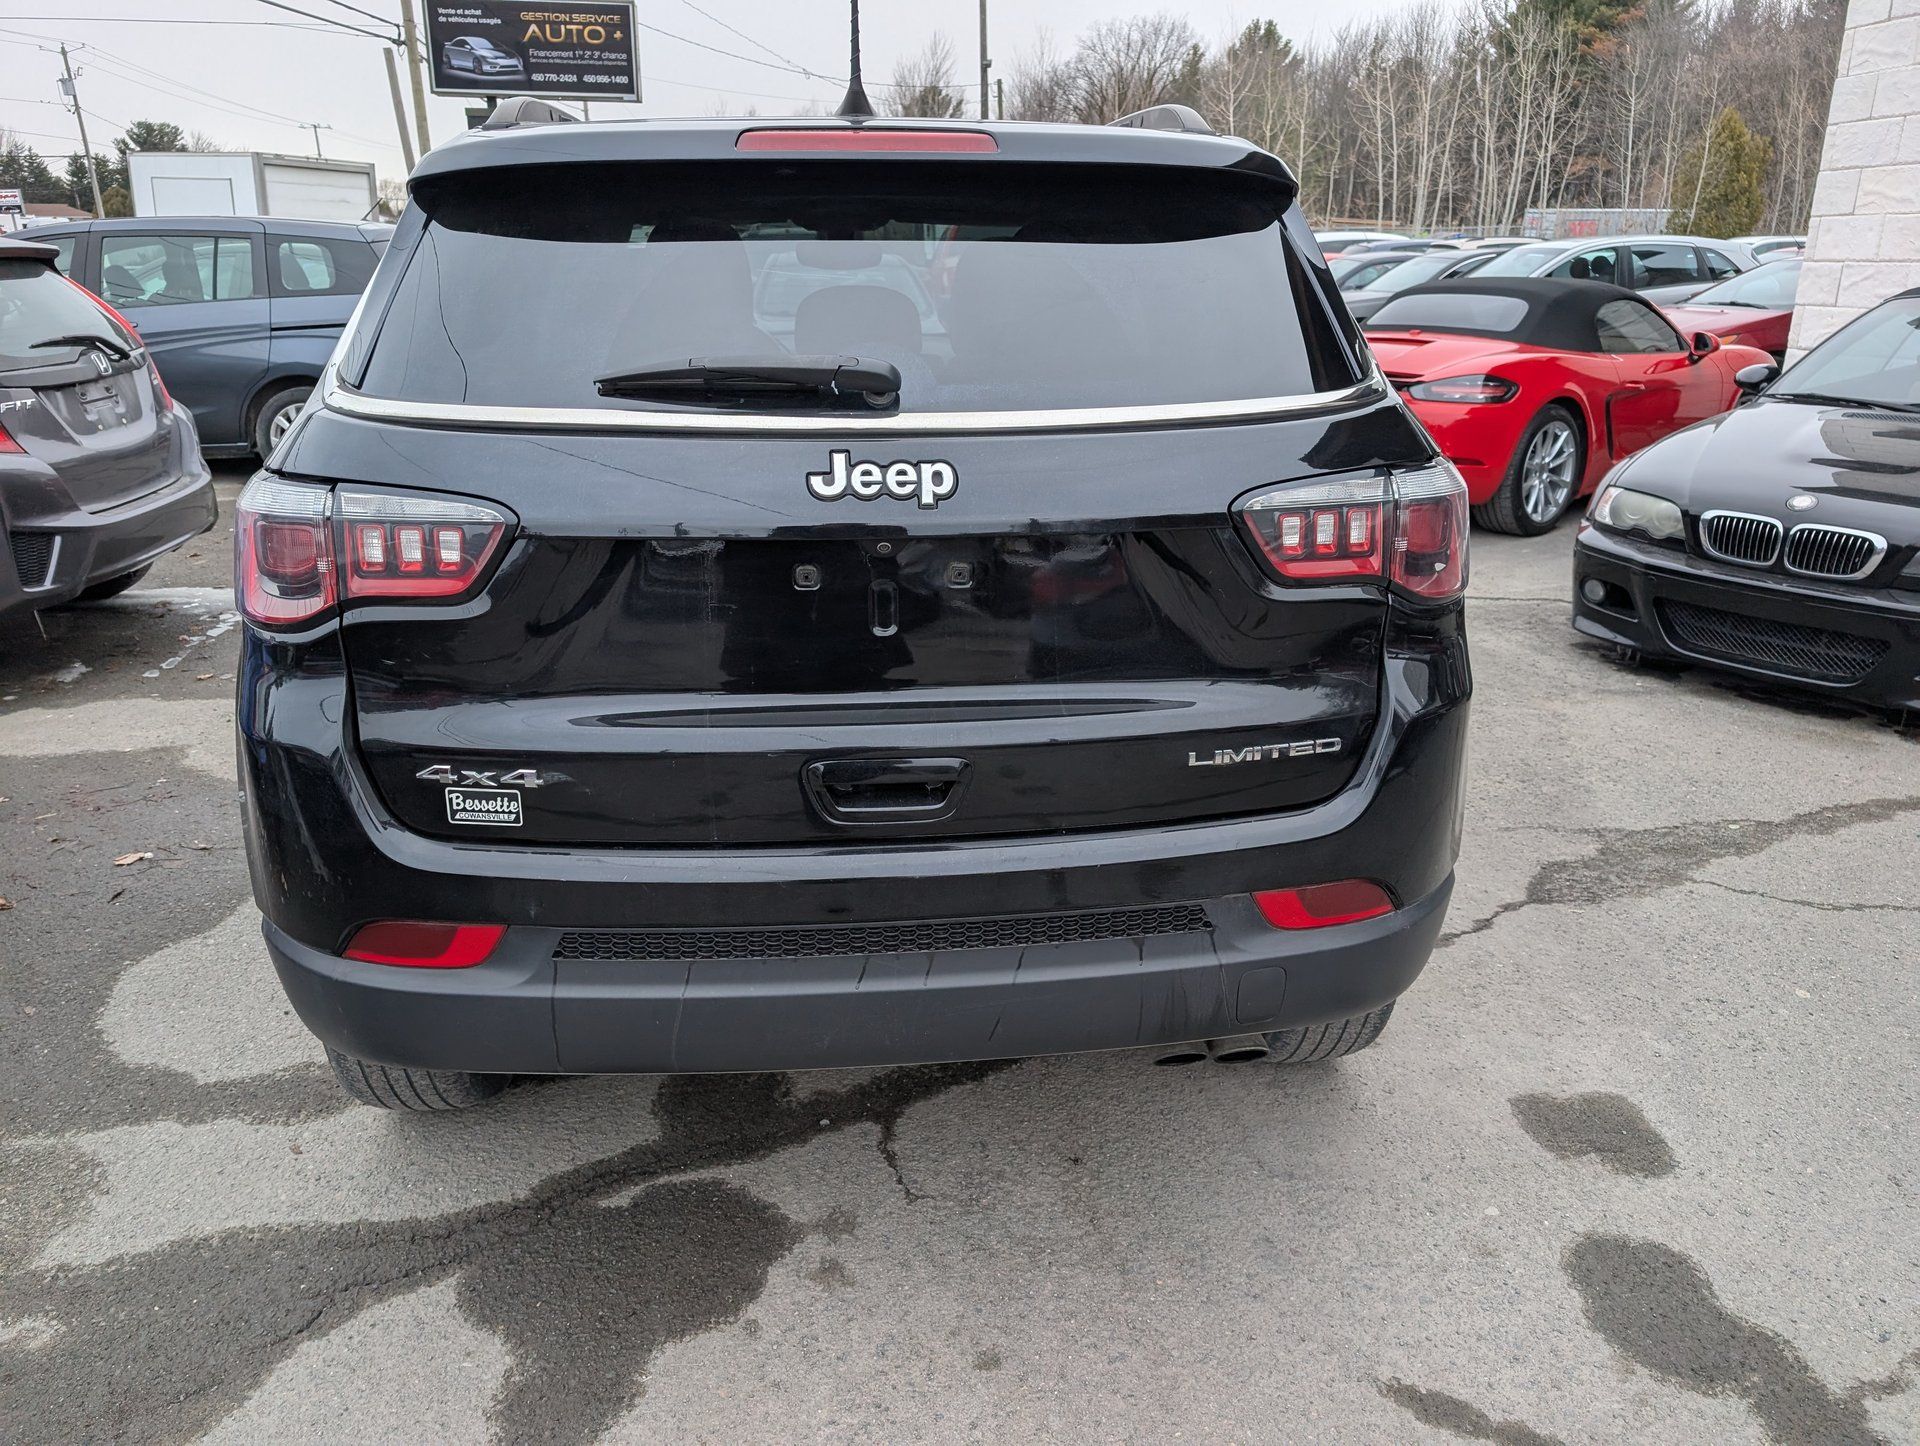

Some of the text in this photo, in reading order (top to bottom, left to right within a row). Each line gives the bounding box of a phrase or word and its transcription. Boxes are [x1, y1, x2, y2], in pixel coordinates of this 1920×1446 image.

[437, 7, 456, 15] Vente
[520, 11, 621, 24] GESTION SERVICE
[447, 16, 478, 24] véhicules
[478, 17, 502, 25] usagés
[521, 23, 606, 44] AUTO
[529, 48, 574, 58] Financement
[601, 51, 628, 60] chance
[0, 398, 36, 413] FIT
[808, 450, 956, 507] Jeep
[1188, 737, 1342, 767] LIMITED
[416, 765, 545, 788] 4x4
[449, 792, 519, 813] Bessette
[457, 812, 513, 821] COWANSVILLE
